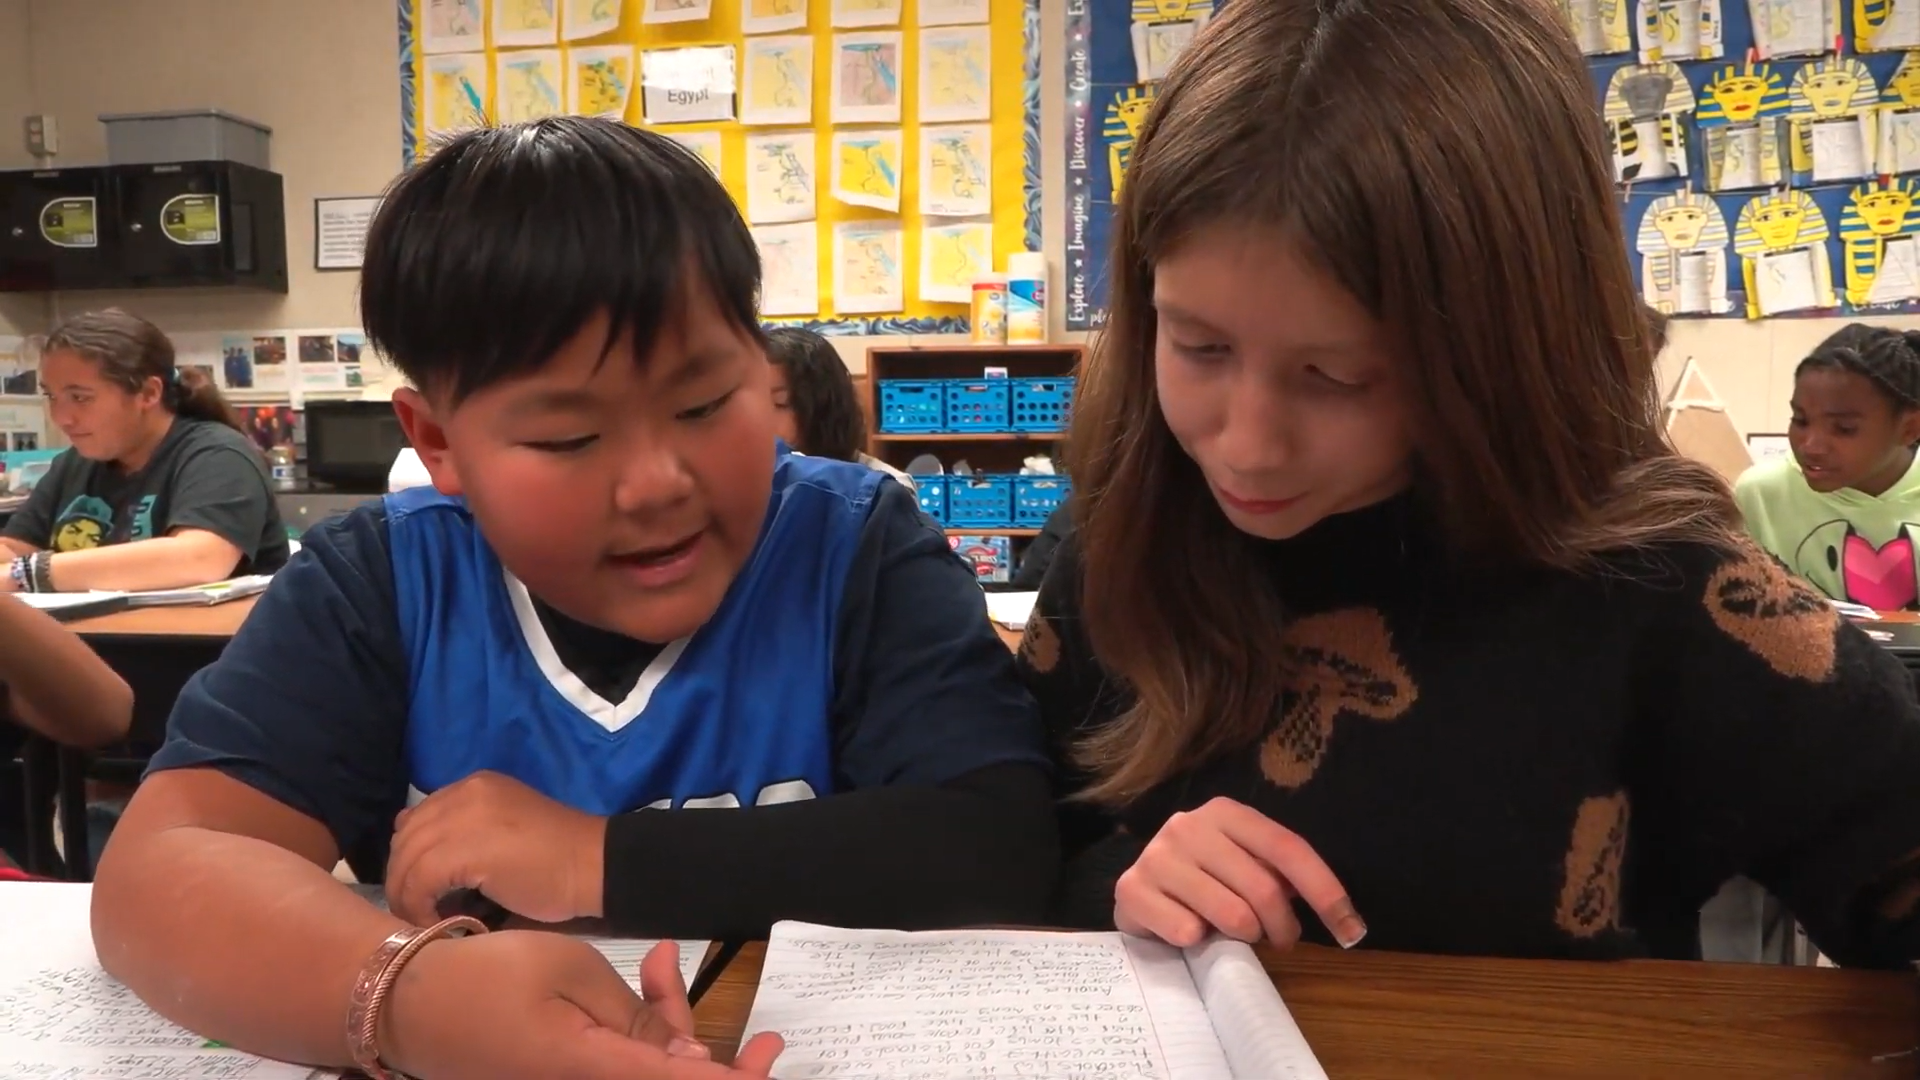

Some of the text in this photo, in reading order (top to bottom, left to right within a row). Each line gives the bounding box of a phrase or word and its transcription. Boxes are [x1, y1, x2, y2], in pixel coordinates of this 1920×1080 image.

[1069, 49, 1088, 91] Create
[1069, 117, 1087, 169] Discover
[1068, 193, 1089, 250] Imagine
[1068, 273, 1089, 321] Explore
